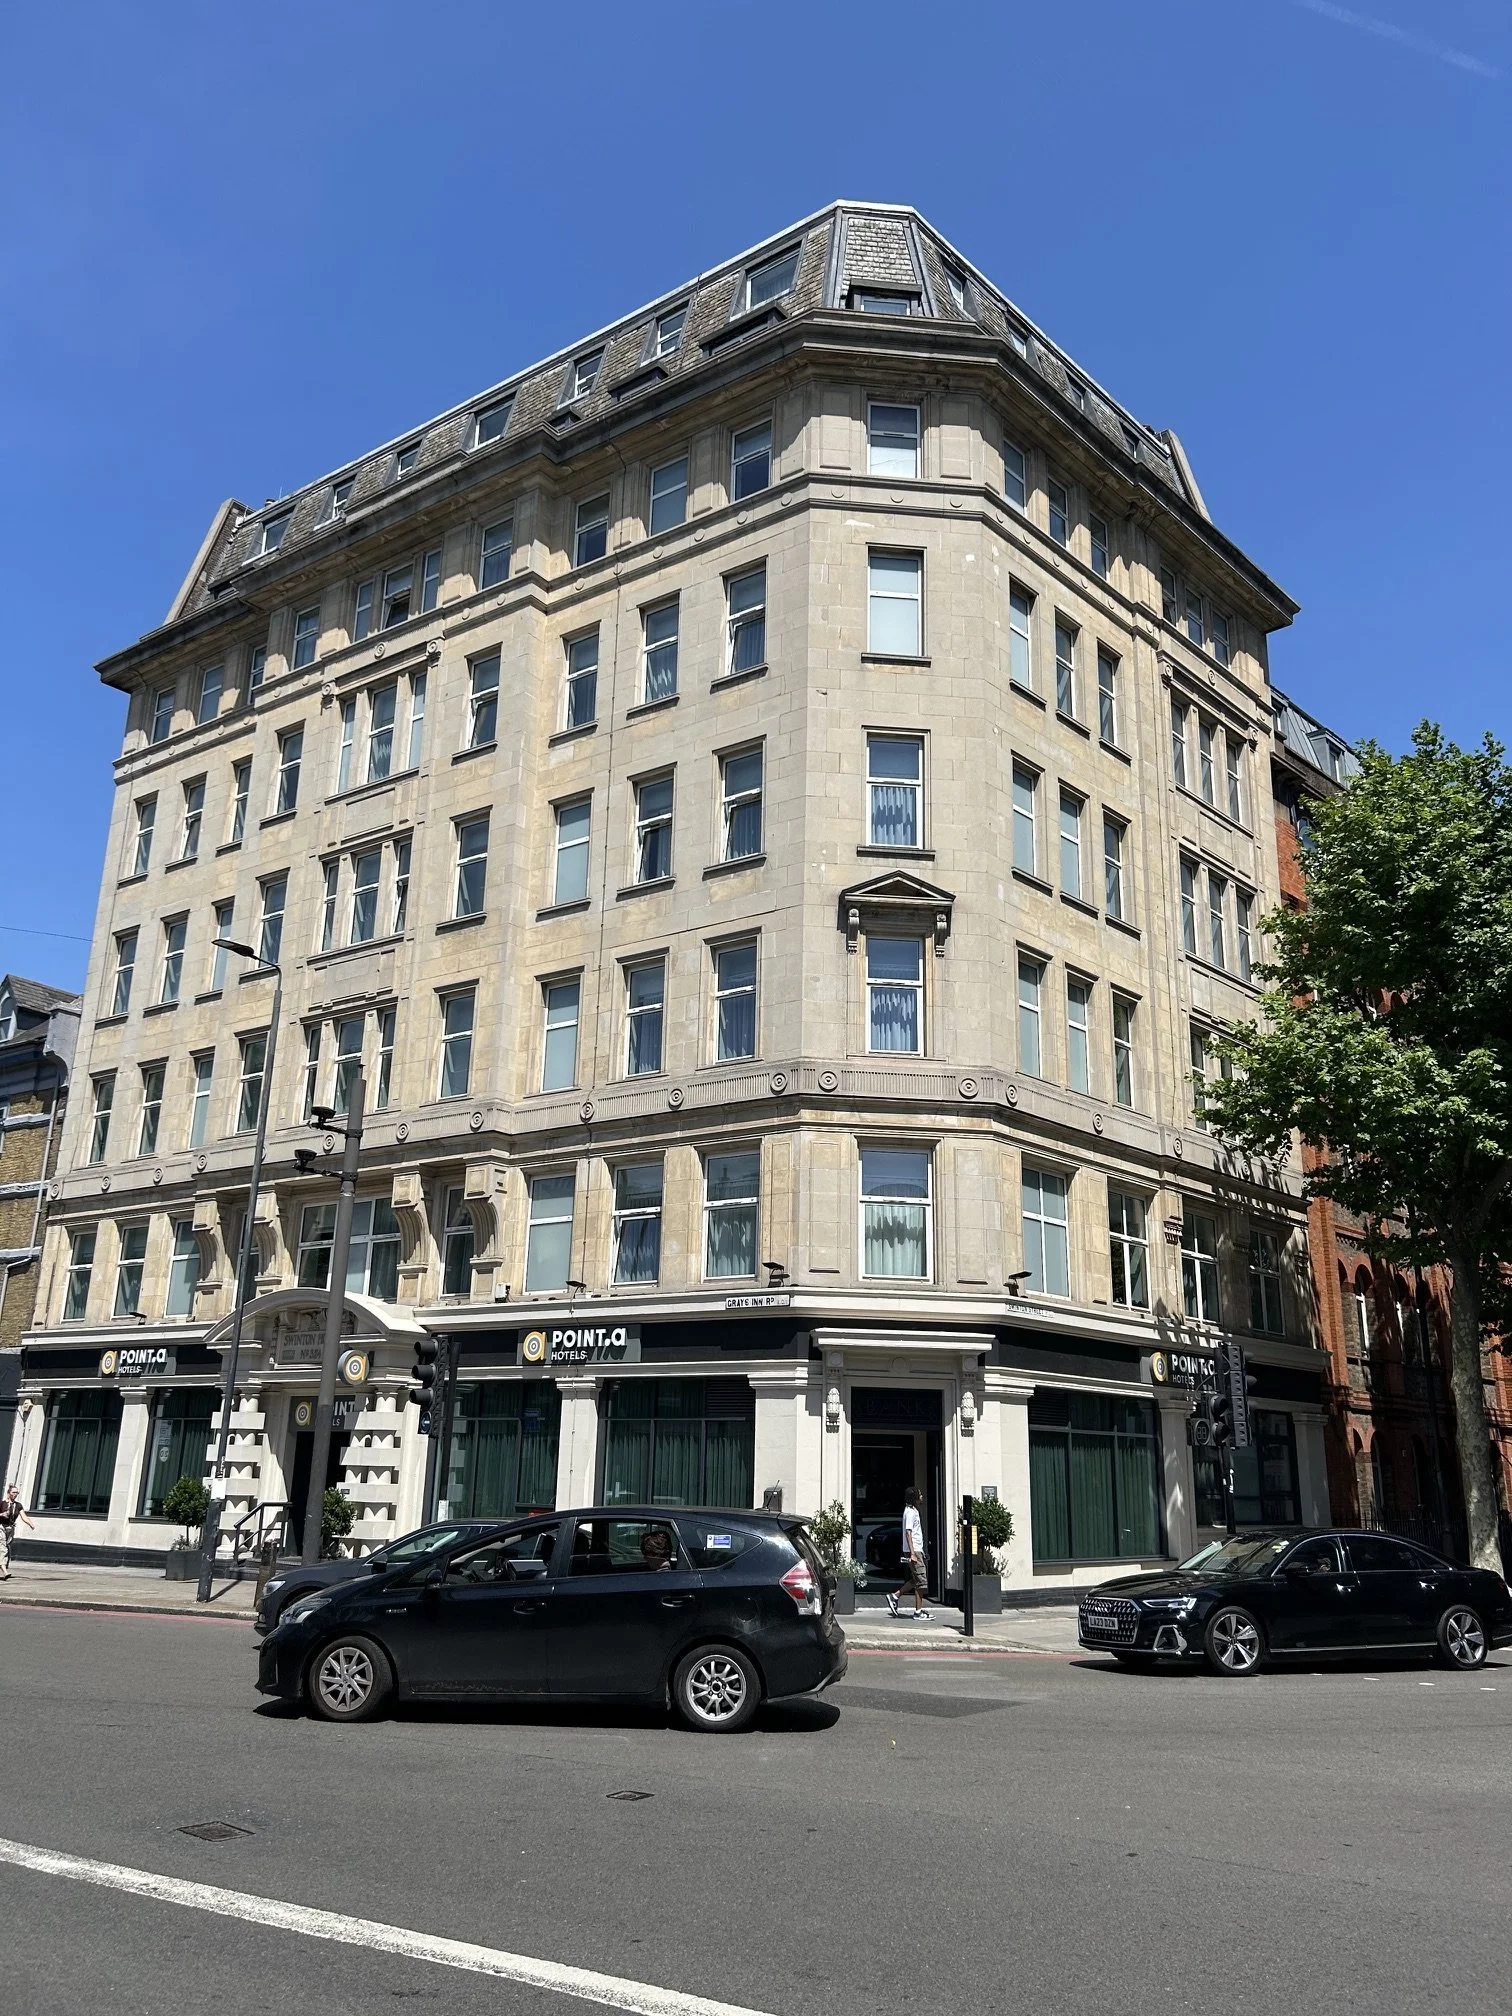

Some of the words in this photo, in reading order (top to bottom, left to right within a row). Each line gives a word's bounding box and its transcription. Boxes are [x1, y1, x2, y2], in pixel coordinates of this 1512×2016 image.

[727, 1299, 750, 1308] GRAYS
[751, 1298, 764, 1306] INN
[550, 1350, 587, 1361] HOTELS
[118, 1365, 141, 1374] HOTELS
